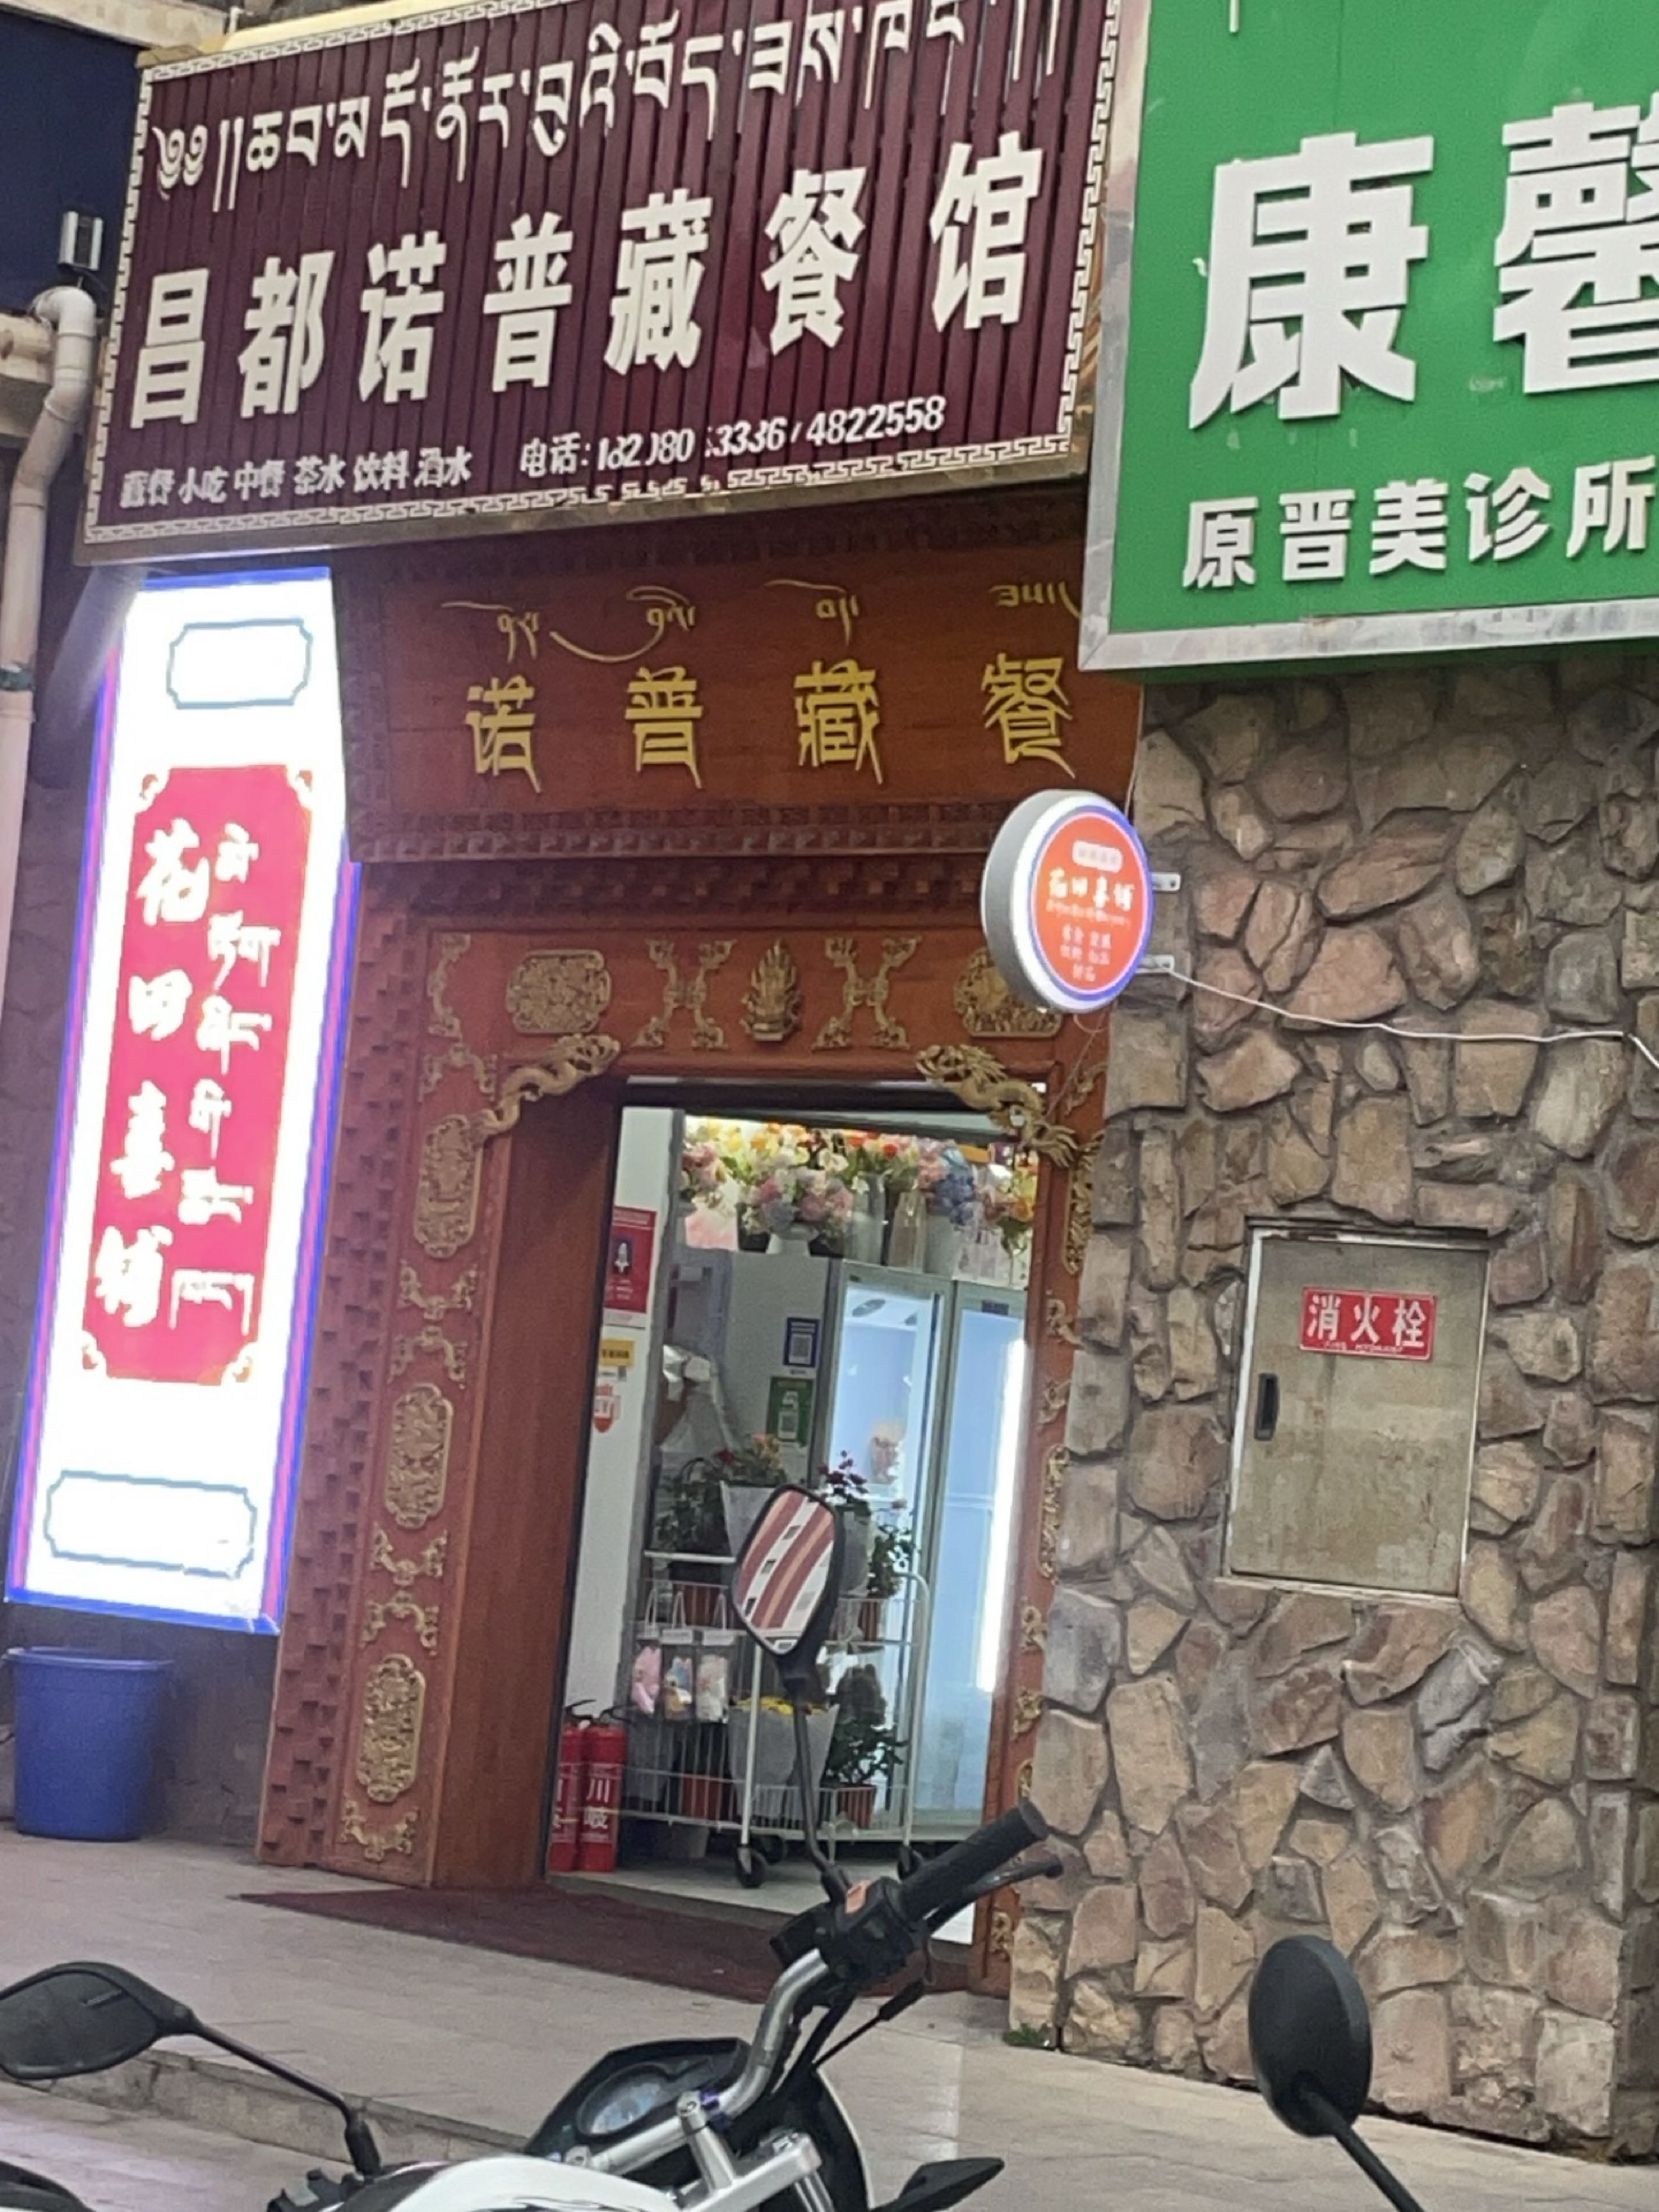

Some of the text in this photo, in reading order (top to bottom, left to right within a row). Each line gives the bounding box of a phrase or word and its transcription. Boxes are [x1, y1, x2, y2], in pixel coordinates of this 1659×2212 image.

[130, 131, 1044, 428] 昌都诺普藏餐馆
[1189, 91, 1659, 429] 康馨
[179, 466, 228, 504] 小吃
[294, 453, 346, 495] 茶水
[353, 449, 410, 493] 饮料
[1183, 454, 1656, 589] 原晋美诊所
[465, 653, 1076, 793] 诺普藏餐
[1307, 1294, 1427, 1348] 消火栓
